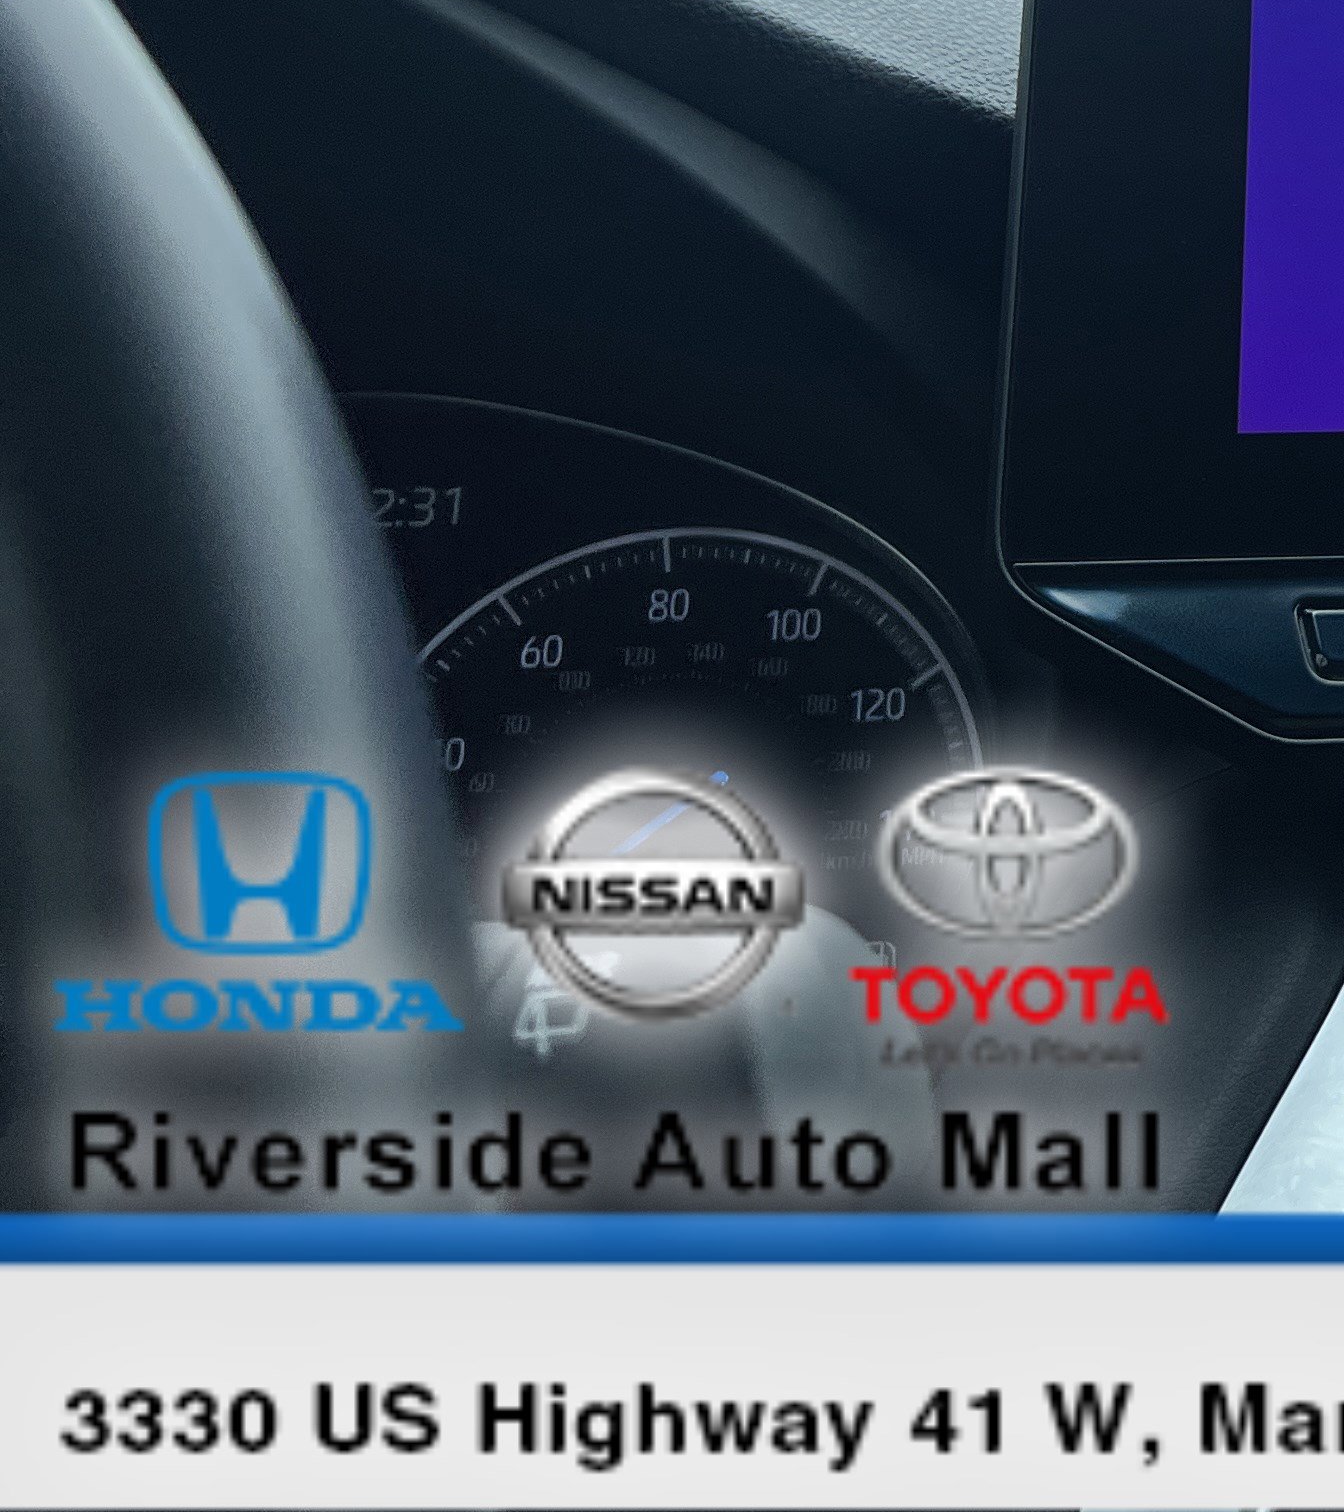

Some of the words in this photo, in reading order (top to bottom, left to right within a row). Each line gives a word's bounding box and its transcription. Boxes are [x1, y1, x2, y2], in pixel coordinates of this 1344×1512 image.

[648, 588, 690, 622] 80
[766, 608, 821, 642] 100
[520, 635, 563, 669] 60
[850, 688, 907, 721] 120
[442, 736, 467, 772] 0
